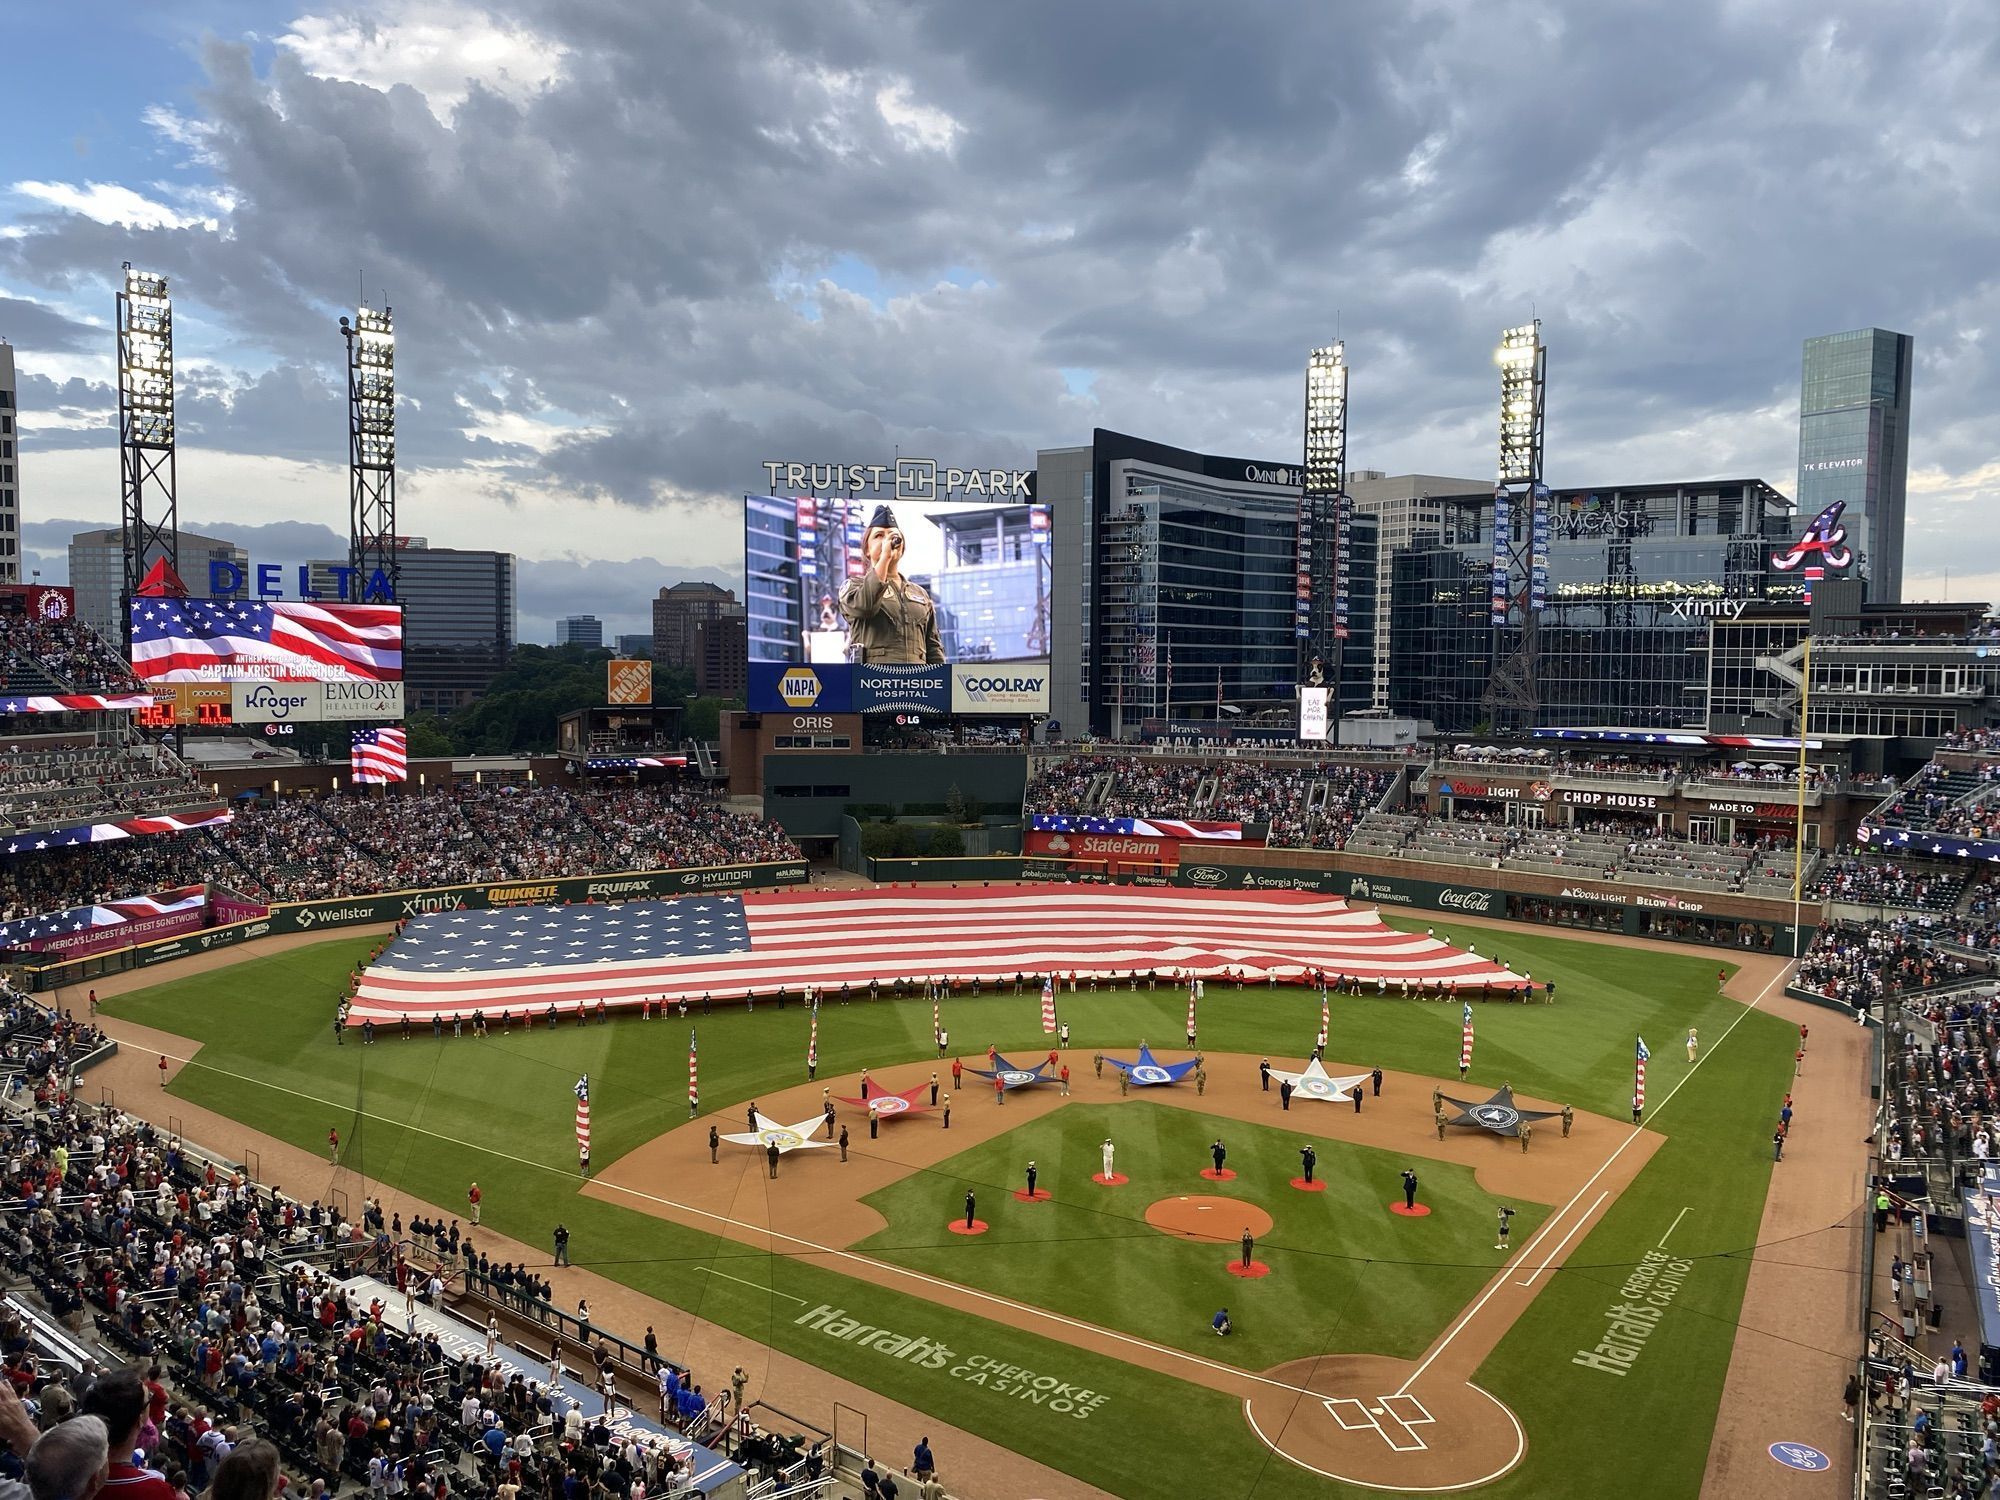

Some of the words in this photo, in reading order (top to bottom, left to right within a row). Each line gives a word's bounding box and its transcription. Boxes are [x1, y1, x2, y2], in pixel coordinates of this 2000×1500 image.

[1818, 459, 1863, 470] ELEVATOR
[762, 461, 887, 492] TRUIST
[946, 468, 1032, 496] PARK
[1536, 486, 1548, 495] 1997
[1535, 500, 1548, 509] 1999
[1535, 514, 1548, 523] 2001
[1548, 509, 1642, 531] OMCAST
[1534, 556, 1546, 565] 2012
[209, 560, 395, 600] DELTA
[1493, 600, 1505, 609] 2021
[1532, 599, 1545, 608] 2022
[1670, 597, 1747, 621] xfinity
[1493, 615, 1505, 624] 2023
[235, 654, 262, 664] ANTHEM
[200, 664, 244, 678] CAPTAIN
[247, 664, 287, 678] KRISTIN
[289, 664, 347, 678] GRISSINGER
[613, 665, 632, 683] THE
[609, 660, 651, 703] HOME
[785, 679, 815, 696] NAPA
[860, 679, 944, 690] NORTHSIDE
[965, 678, 1045, 692] COOLRAY
[152, 687, 177, 696] MEGA
[325, 682, 400, 700] EMORY
[626, 676, 651, 703] DEPOT
[875, 690, 929, 698] HOSPITAL
[246, 685, 307, 718] Kroger
[326, 702, 398, 711] HEALTHCARE
[200, 704, 221, 718] 77
[793, 716, 833, 729] ORIS
[907, 716, 920, 724] LG
[279, 724, 294, 734] LG
[1171, 725, 1201, 734] Braves
[1453, 781, 1488, 796] Coors
[1488, 787, 1520, 798] LIGHT
[1563, 791, 1602, 804] CHOP
[1607, 796, 1656, 809] HOUSE
[1709, 803, 1739, 812] MADE
[1741, 805, 1754, 813] TO
[702, 870, 752, 883] HYUNDAI
[1193, 868, 1220, 881] Ford
[587, 880, 651, 896] EQUIFAX
[1257, 876, 1291, 888] Georgia
[1297, 879, 1320, 889] Power
[1372, 884, 1392, 892] KAISER
[488, 885, 559, 901] QUIKRETE
[1372, 891, 1411, 902] PERMANENTE
[1438, 888, 1492, 912] Coca-Cola
[1571, 887, 1600, 900] Coors
[1602, 894, 1626, 903] LIGHT
[402, 892, 462, 917] xfinity
[1678, 900, 1703, 912] CHOP
[318, 907, 374, 923] Wellstar
[43, 936, 85, 953] AMERICA'S
[85, 929, 119, 944] LARGEST
[166, 911, 200, 927] NETWORK
[212, 931, 233, 940] TYM
[1619, 1249, 1670, 1300] CHEROKEE
[1646, 1256, 1695, 1307] CASINOS
[414, 1318, 469, 1347] TRUIST
[966, 1355, 1111, 1408] CHEROKEE
[551, 1389, 567, 1400] OF
[949, 1365, 1096, 1419] CASINOS
